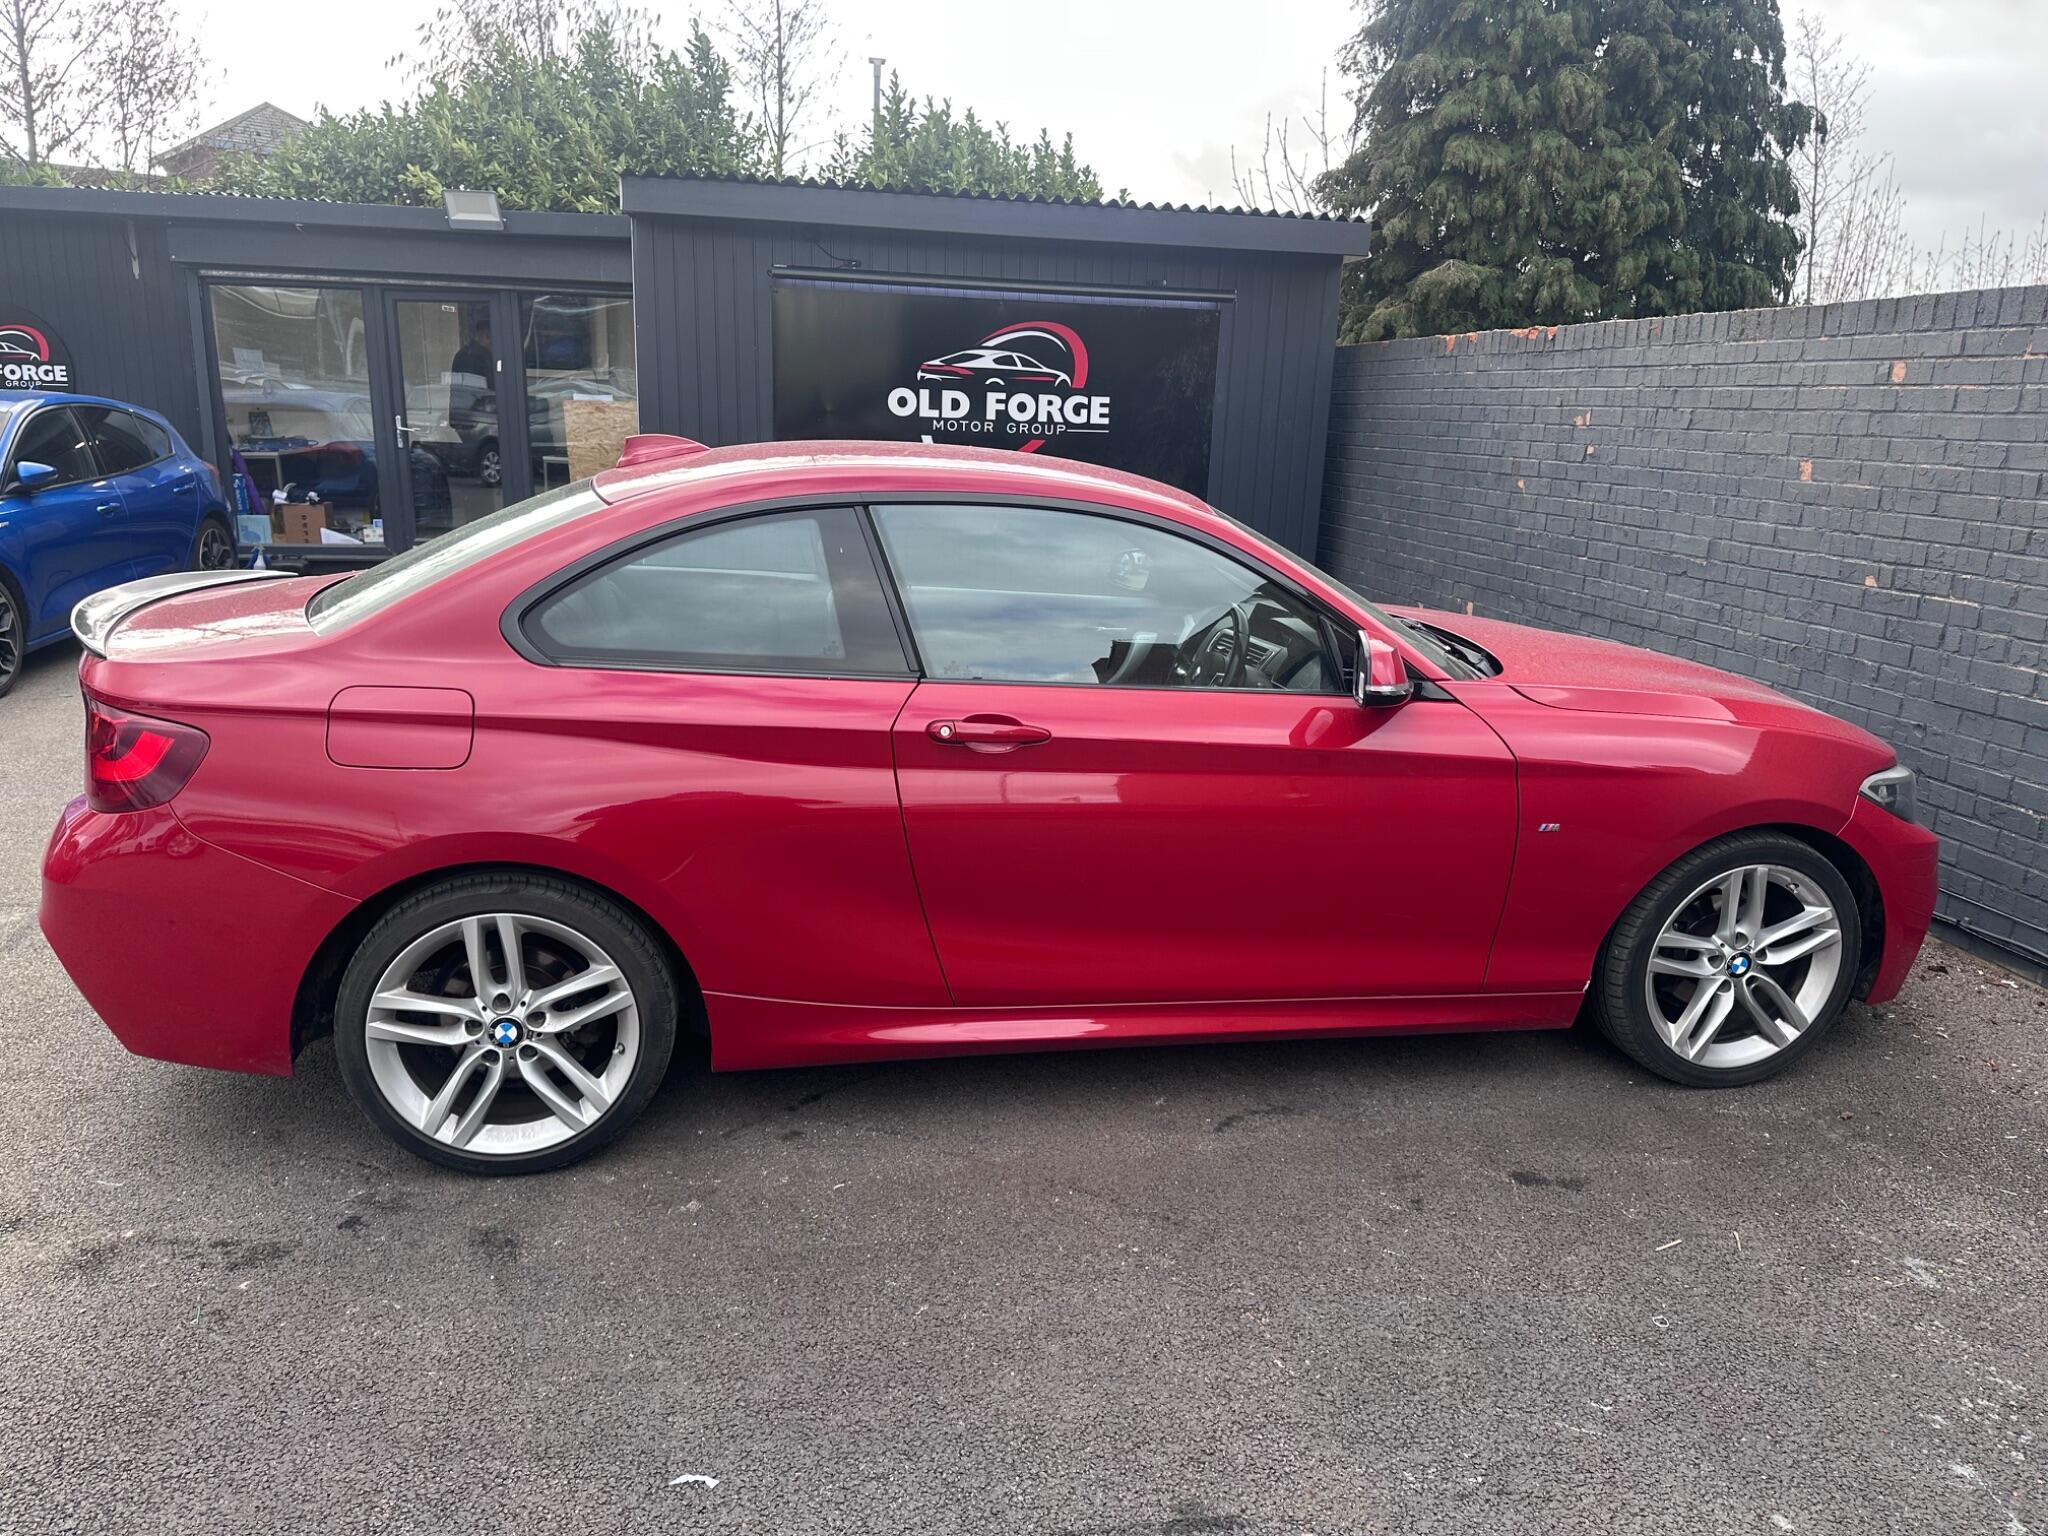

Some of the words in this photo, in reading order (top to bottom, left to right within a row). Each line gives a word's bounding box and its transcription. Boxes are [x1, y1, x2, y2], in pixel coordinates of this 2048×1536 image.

[0, 364, 68, 381] ORGE
[5, 380, 42, 388] GROUP
[887, 387, 970, 419] OLD
[985, 391, 1111, 425] FORGE
[932, 420, 994, 433] MOTOR
[1006, 422, 1066, 435] GROUP
